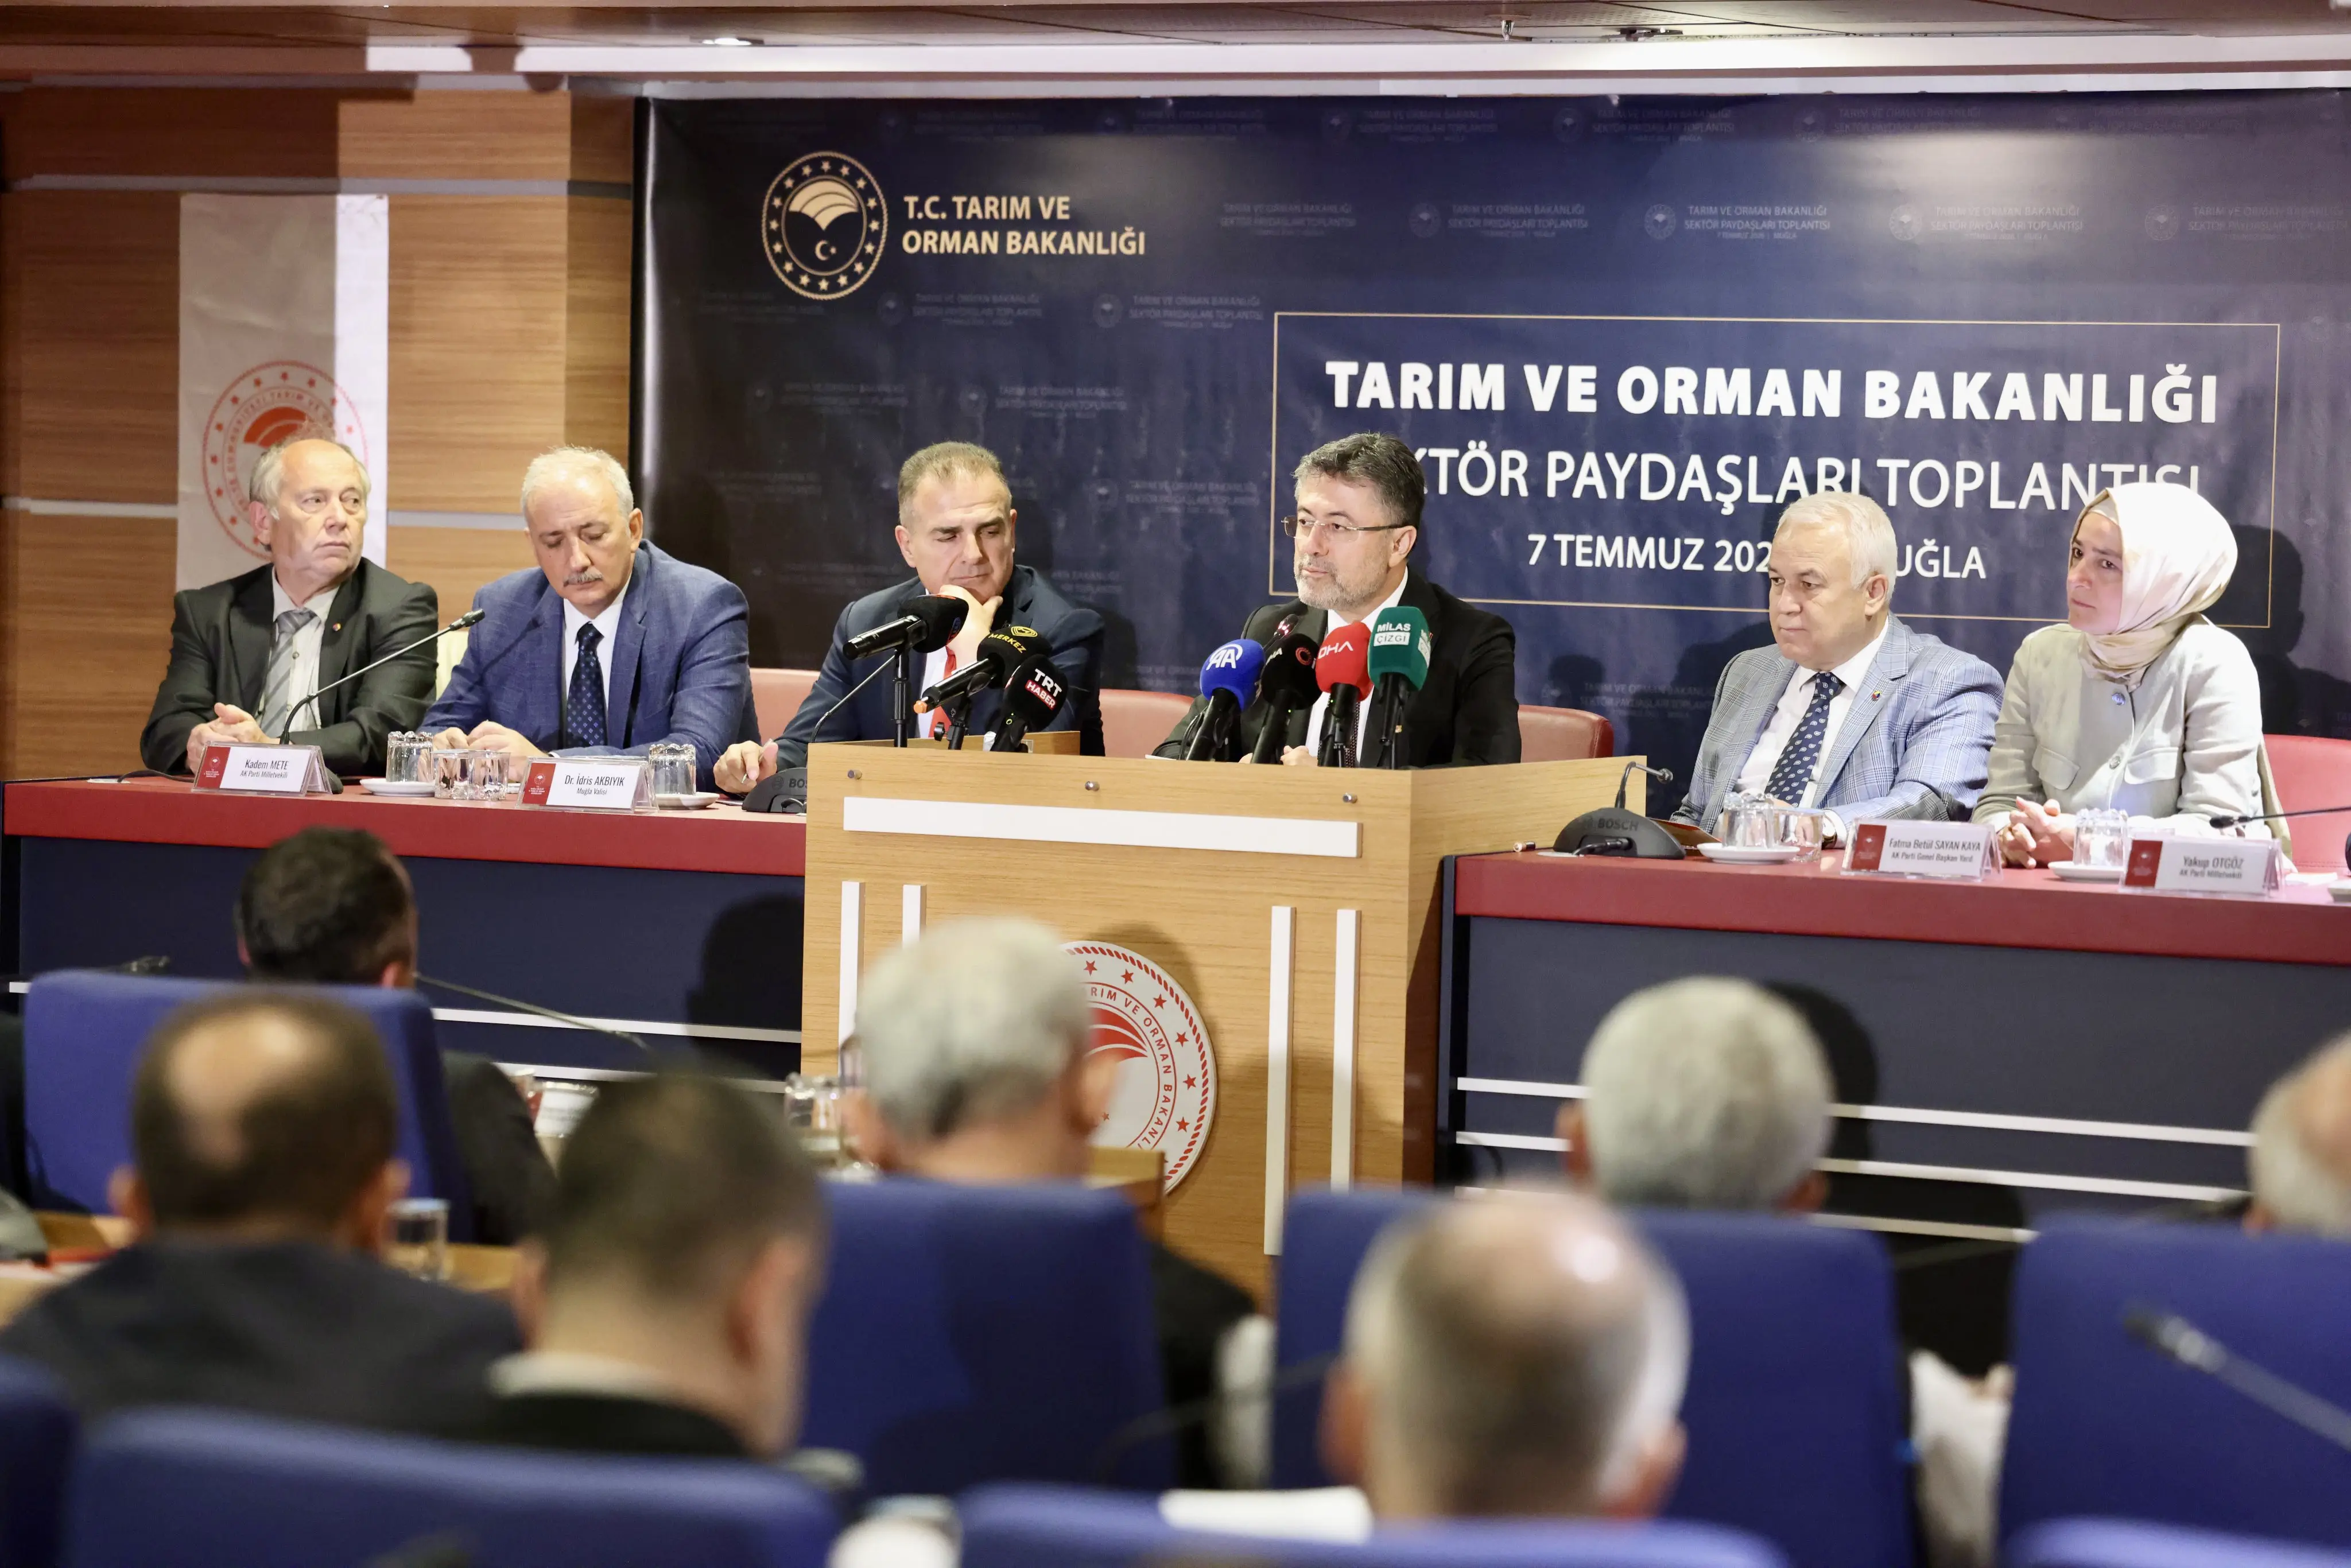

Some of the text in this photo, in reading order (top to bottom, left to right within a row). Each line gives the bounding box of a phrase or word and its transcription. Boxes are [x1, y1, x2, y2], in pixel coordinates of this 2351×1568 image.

[904, 196, 1070, 219] T.C. TARIM VE
[1689, 205, 1718, 215] TARIM
[1720, 206, 1732, 216] VE
[1734, 206, 1772, 216] ORMAN
[902, 226, 1146, 255] ORMAN BAKANLIĞI
[1325, 360, 2217, 424] TARIM VE ORMAN BAKANLIĞI
[1414, 440, 1528, 497] TÖR
[1547, 451, 1861, 515] PAYDAŞLARI
[1527, 534, 1986, 579] 7 TEMMUZ 202 UĞLA
[1377, 622, 1411, 632] MİLAS
[988, 633, 1027, 653] MERKEZ
[1206, 648, 1236, 671] AA
[1034, 668, 1062, 697] TRT
[1027, 681, 1056, 708] HABER
[245, 759, 289, 770] Kadem METE
[564, 773, 625, 786] Dr. İdris AKBIYIK
[576, 787, 593, 796] Muğla
[1597, 818, 1639, 830] BOSCH
[1889, 838, 1981, 851] Fatma Betül SAYAN KAYA
[1091, 987, 1173, 1150] RIM VE ORMAN BAKANLI
